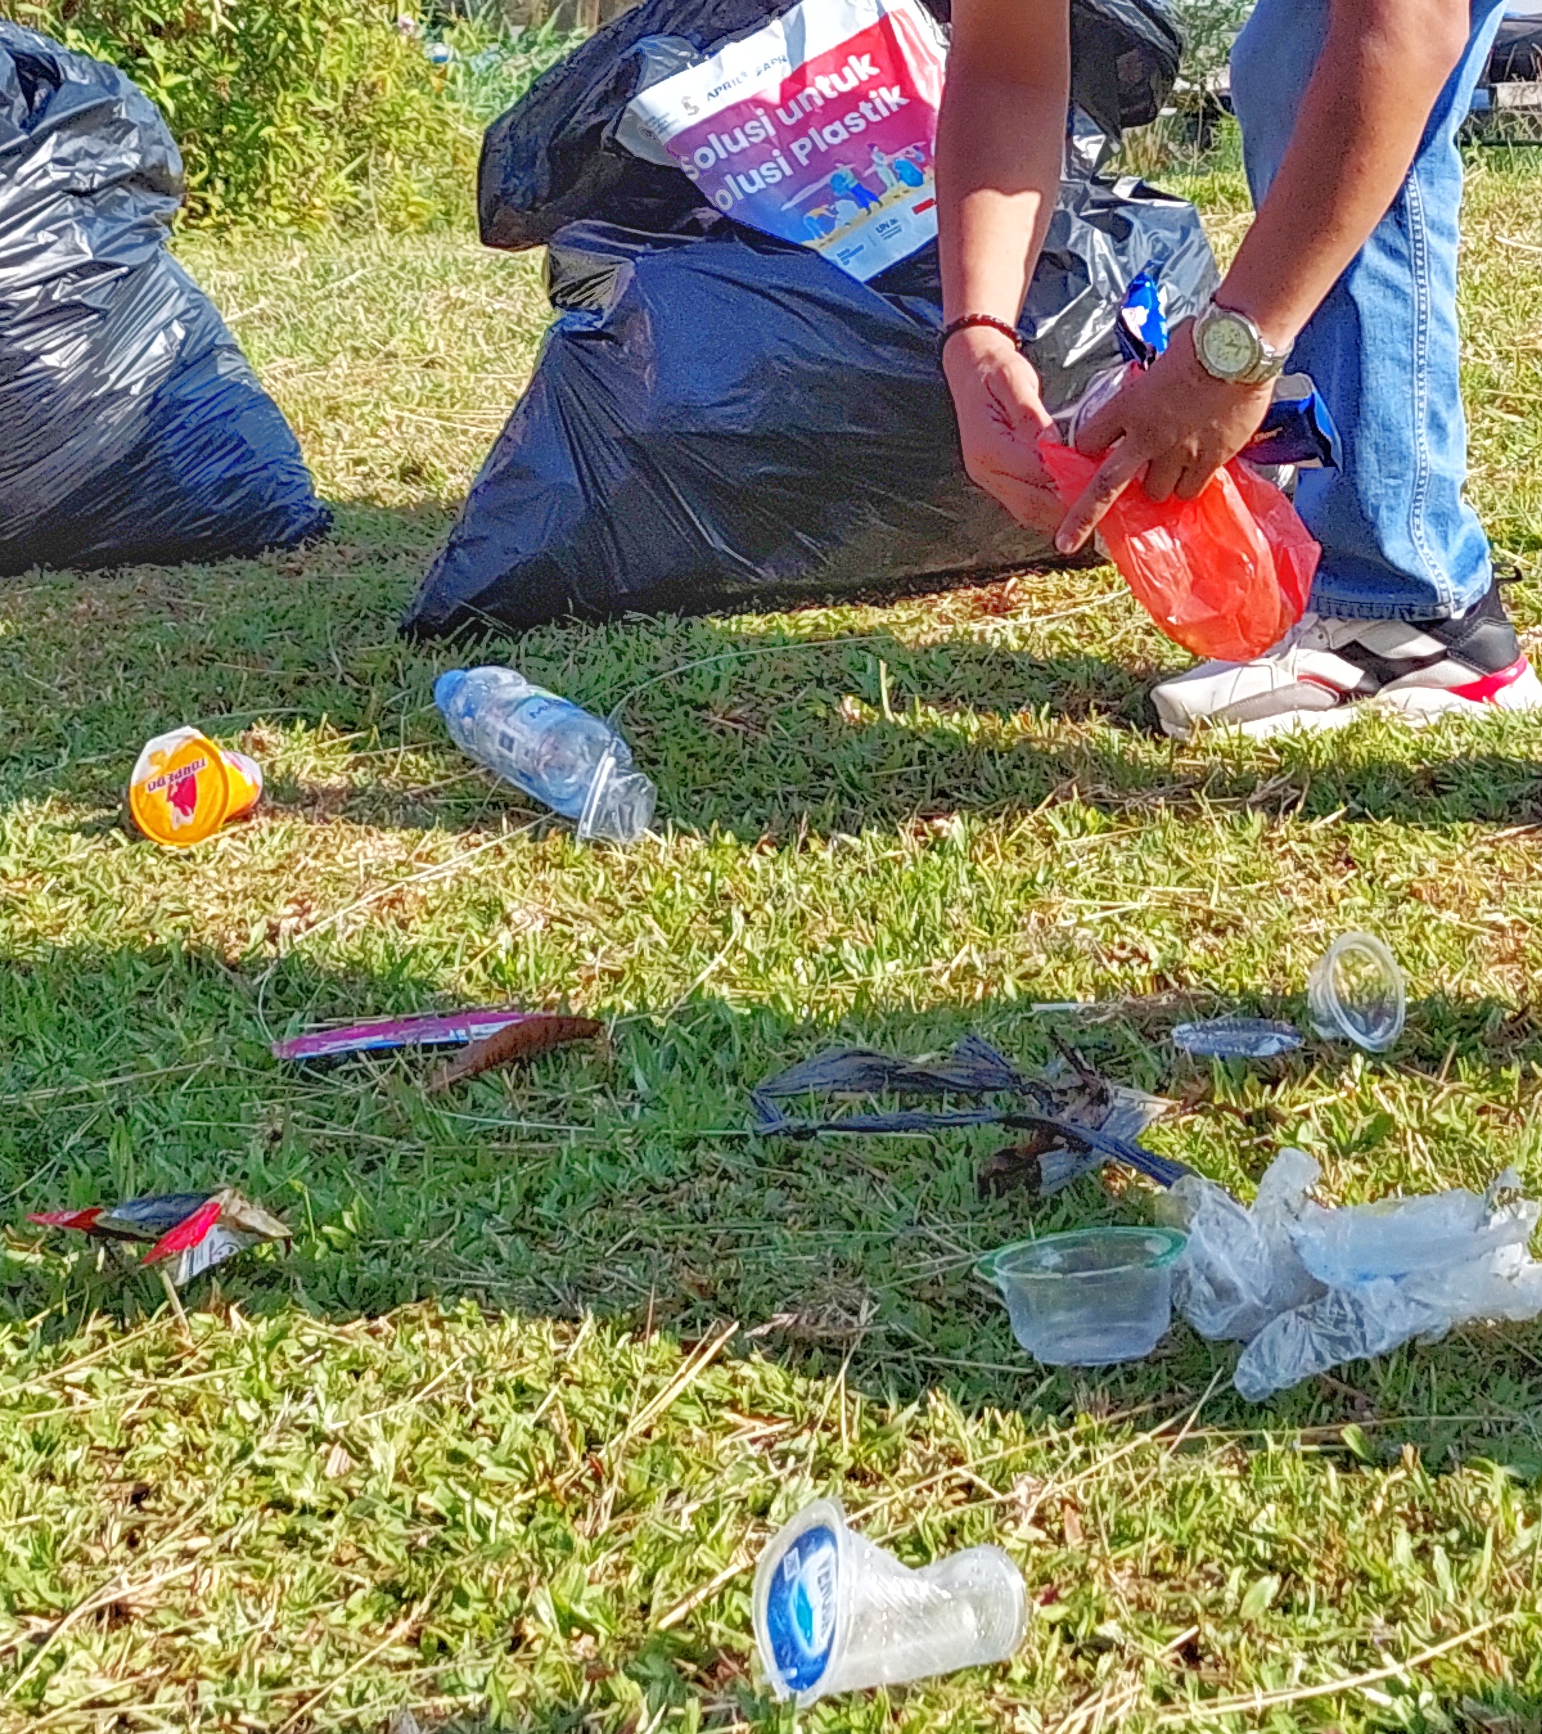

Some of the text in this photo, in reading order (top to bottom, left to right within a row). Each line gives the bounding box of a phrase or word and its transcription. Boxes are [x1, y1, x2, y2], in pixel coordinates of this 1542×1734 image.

[679, 53, 880, 181] Solusi untuk
[707, 85, 910, 211] olusi Plastik
